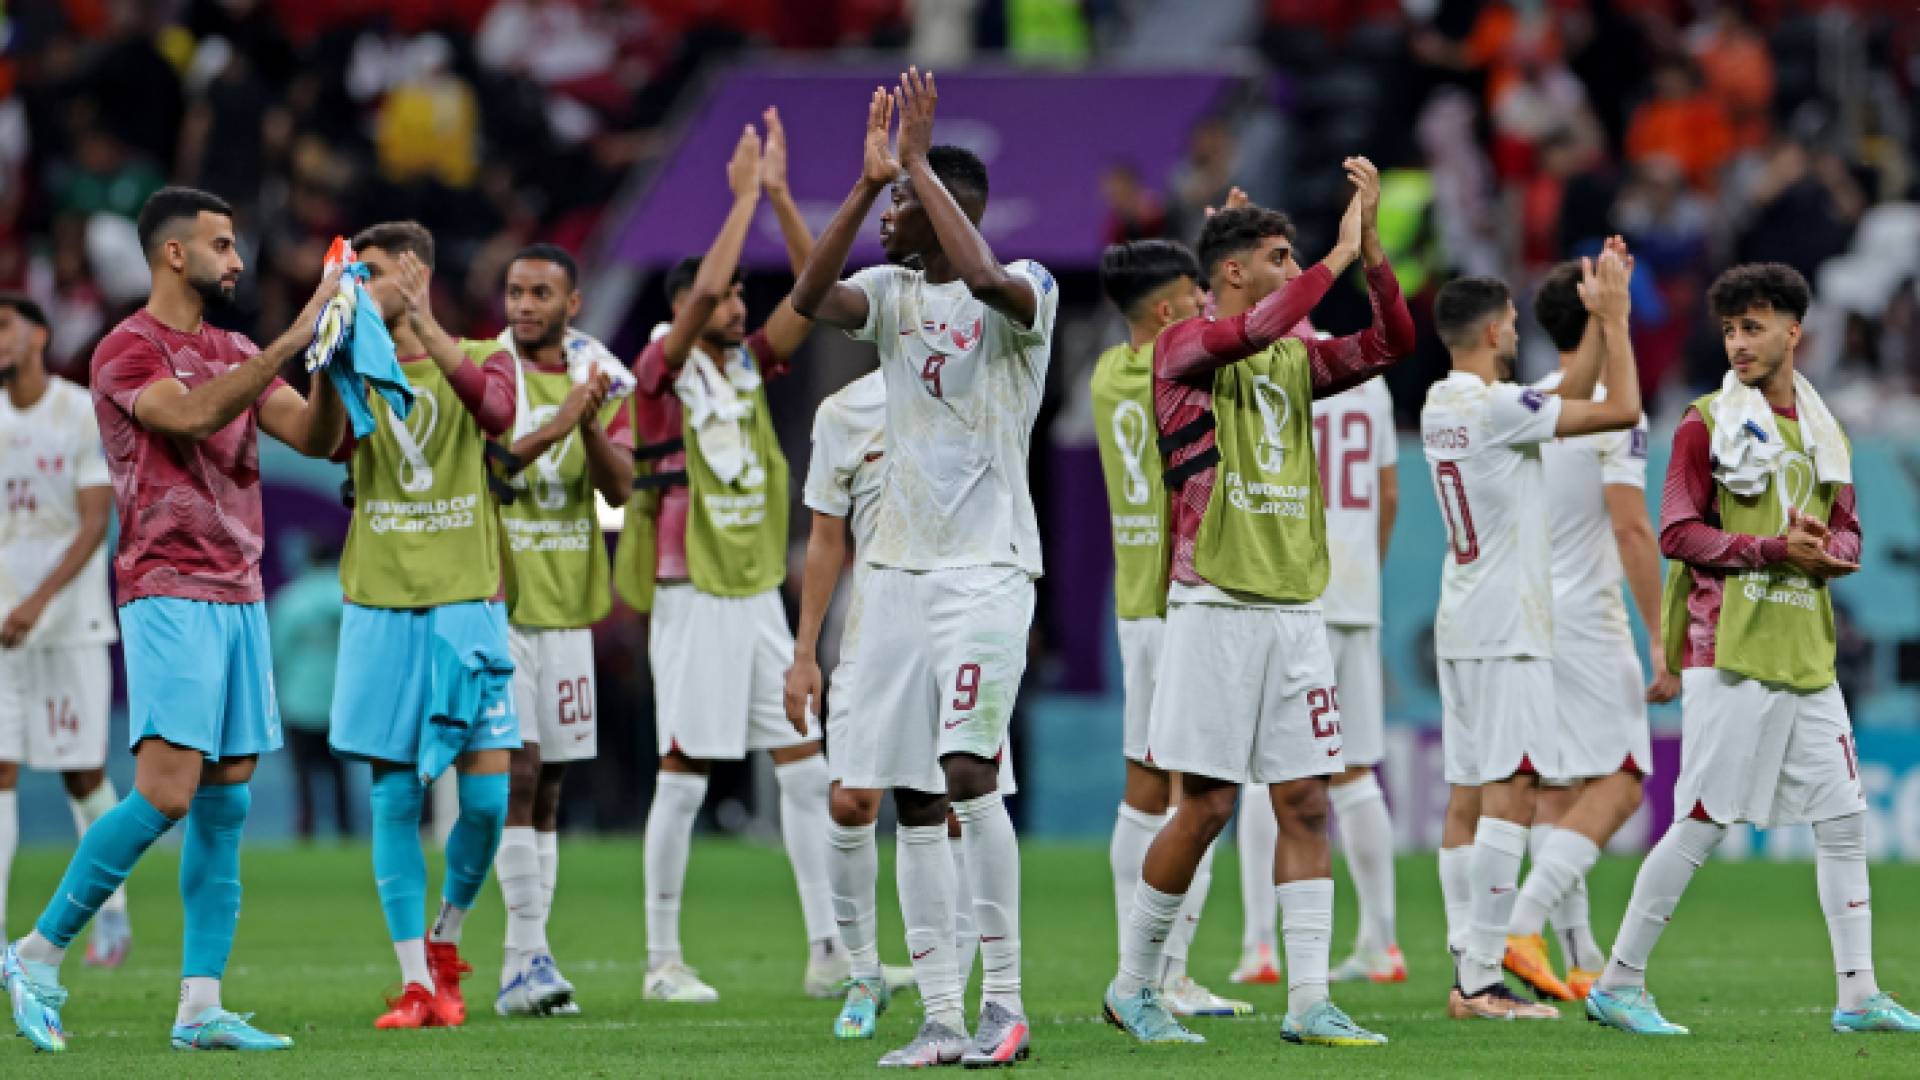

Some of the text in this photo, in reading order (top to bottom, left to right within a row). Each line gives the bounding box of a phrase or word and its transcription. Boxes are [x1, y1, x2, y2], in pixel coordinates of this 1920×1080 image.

[921, 354, 946, 399] 9
[1312, 411, 1373, 509] 12
[1437, 459, 1480, 565] 0
[557, 674, 593, 726] 20
[953, 663, 981, 711] 9
[46, 695, 80, 737] 14
